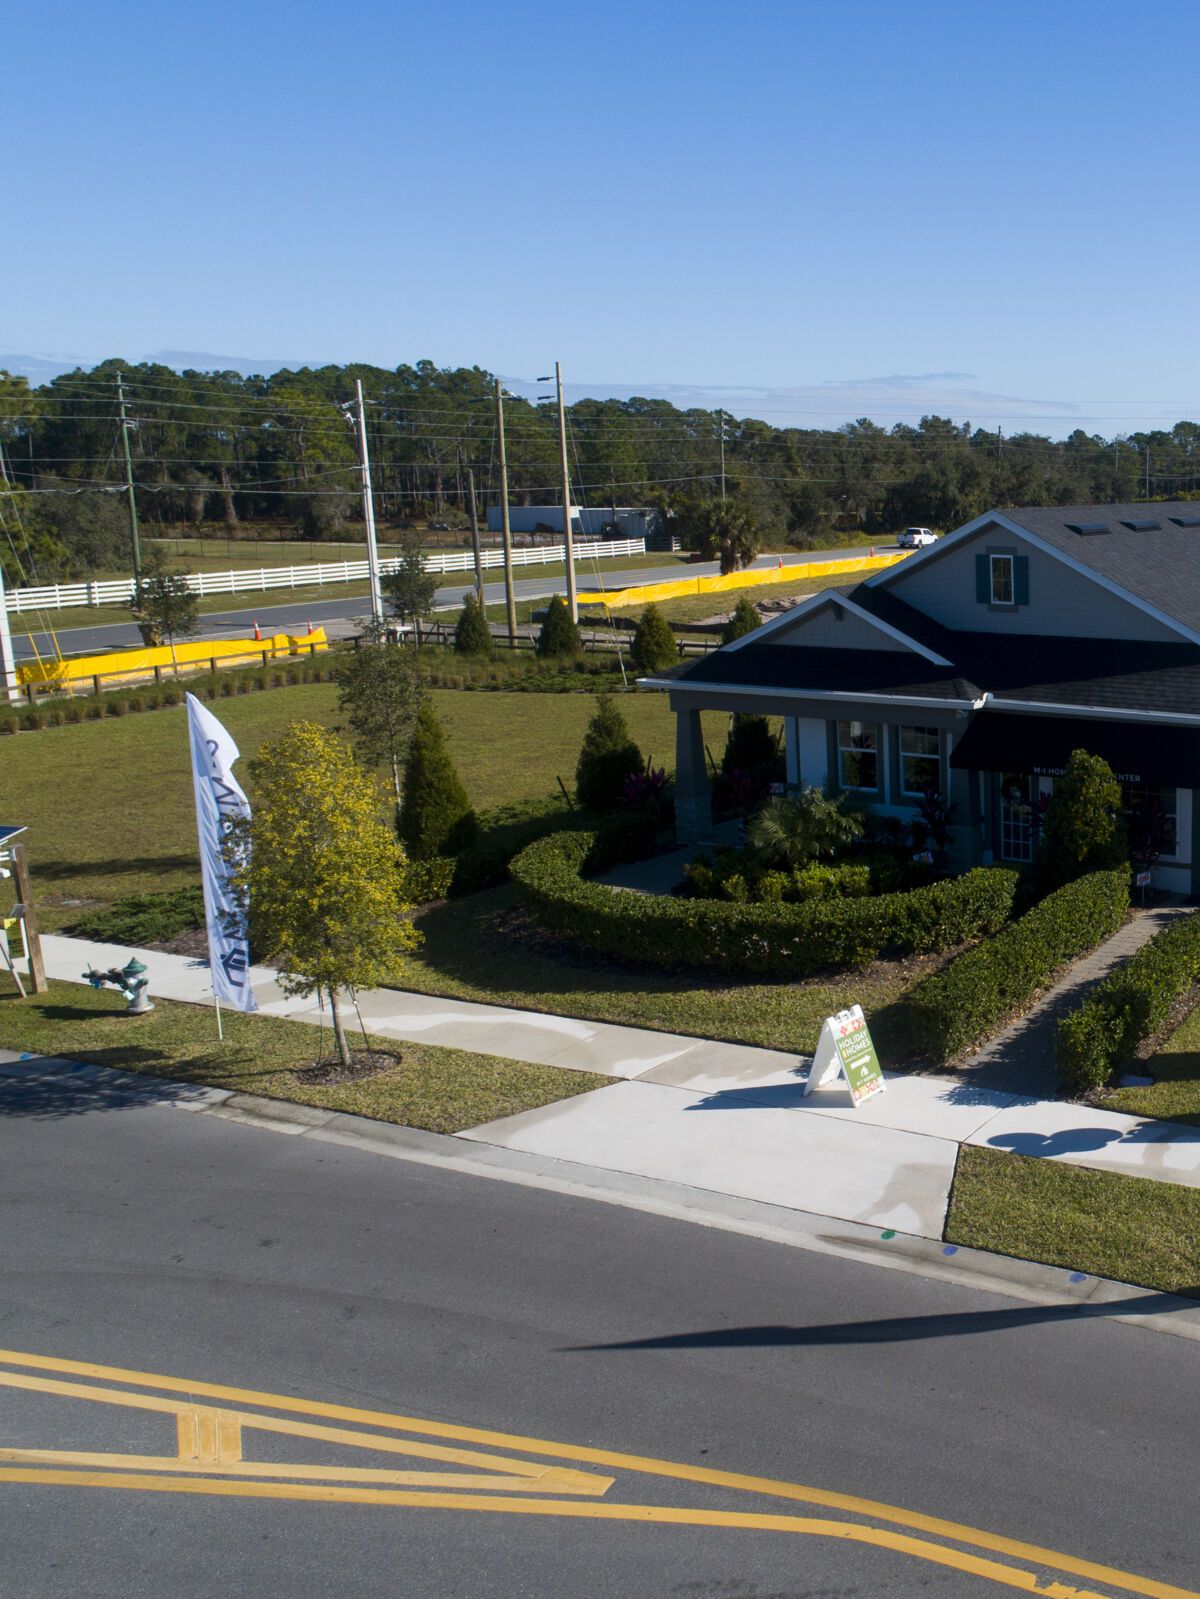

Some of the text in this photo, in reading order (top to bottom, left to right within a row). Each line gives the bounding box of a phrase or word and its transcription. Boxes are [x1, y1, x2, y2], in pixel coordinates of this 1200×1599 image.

[1113, 773, 1141, 782] ENTER
[839, 1030, 867, 1049] HOLIDAY
[846, 1038, 870, 1056] HOMES
